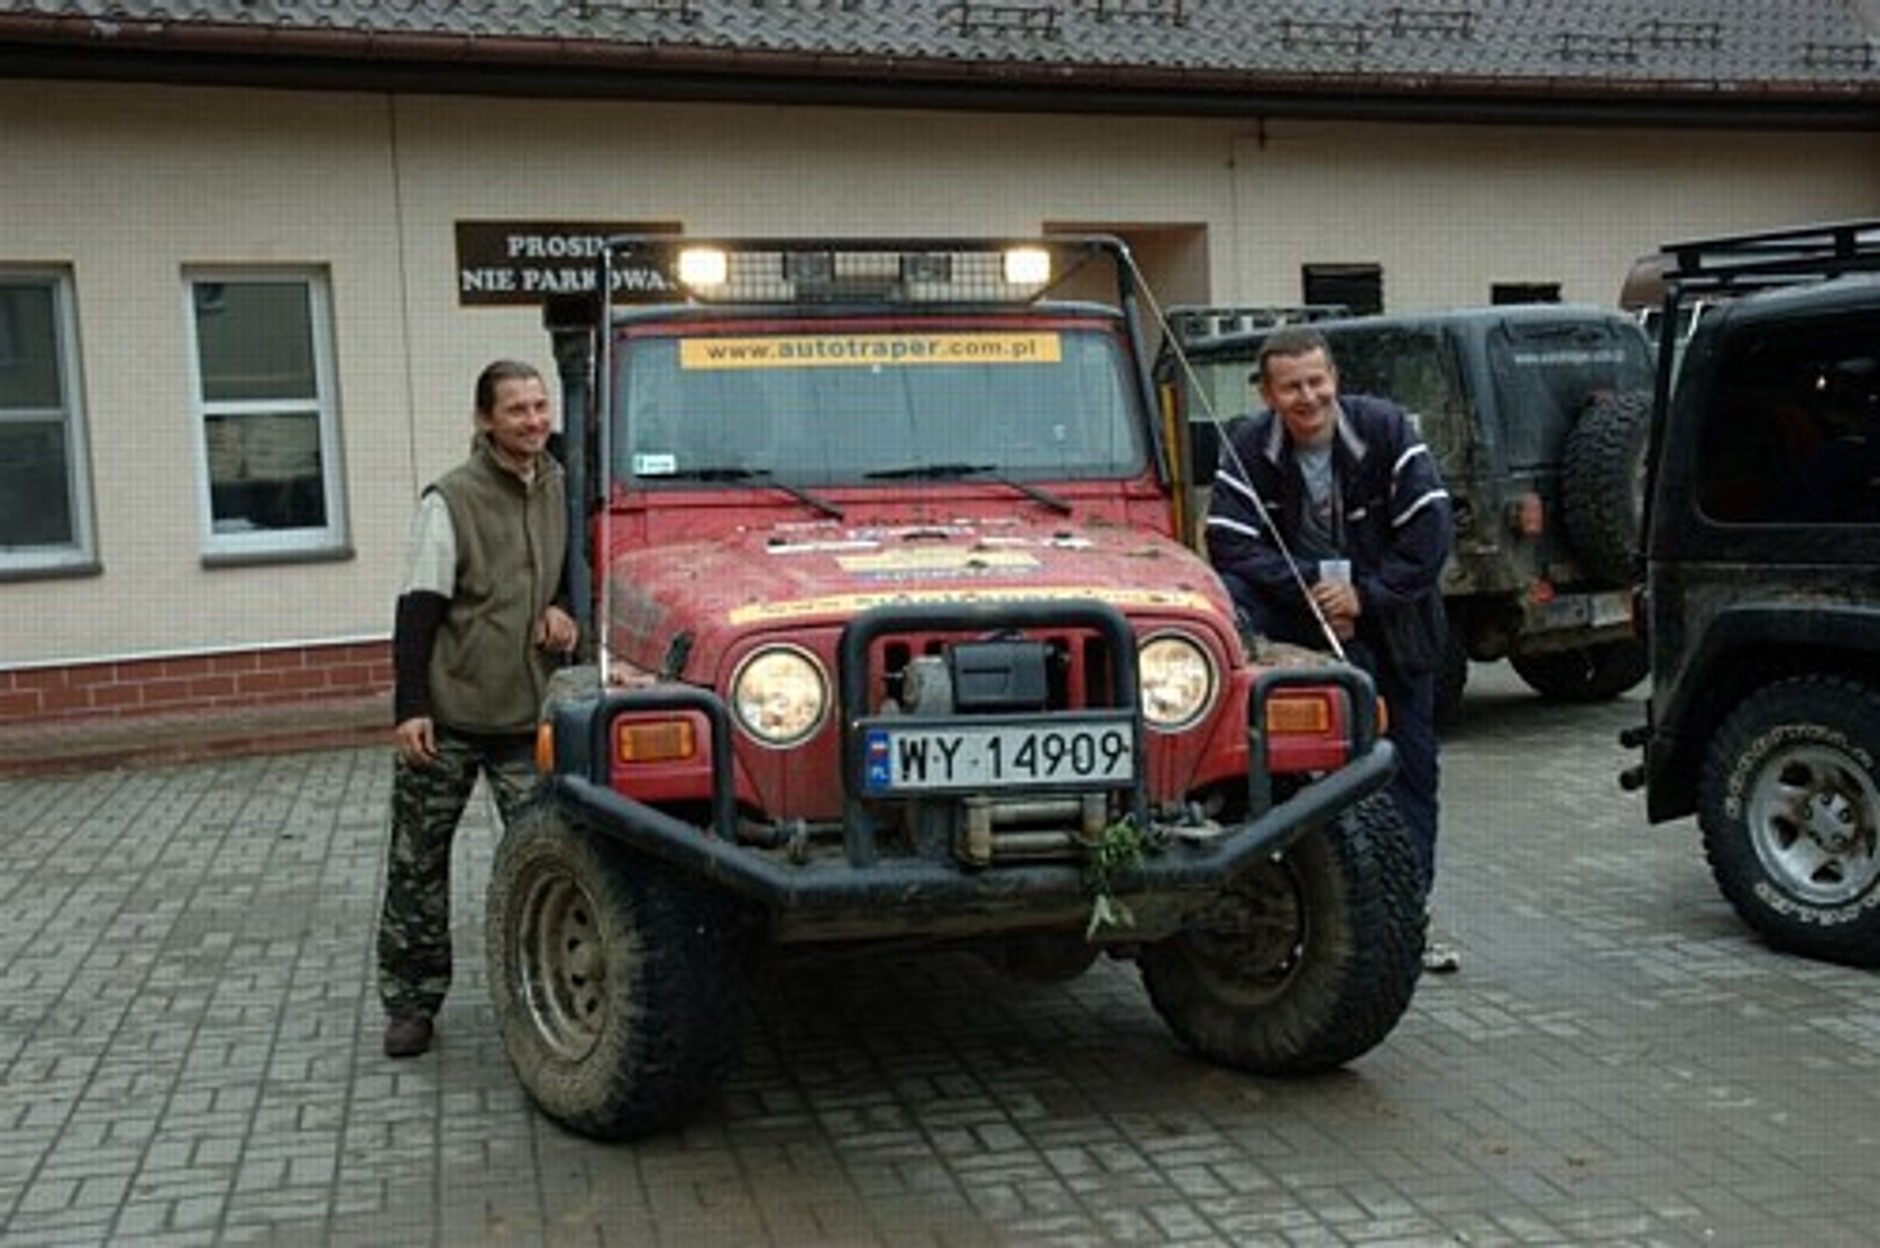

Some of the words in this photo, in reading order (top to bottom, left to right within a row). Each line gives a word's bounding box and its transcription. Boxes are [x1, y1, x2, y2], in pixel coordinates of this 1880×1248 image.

[507, 235, 633, 258] PROSI
[462, 269, 516, 291] NIE
[706, 338, 1036, 359] www.autotraper.com.pl
[900, 736, 963, 781] WY
[987, 730, 1127, 779] 14909
